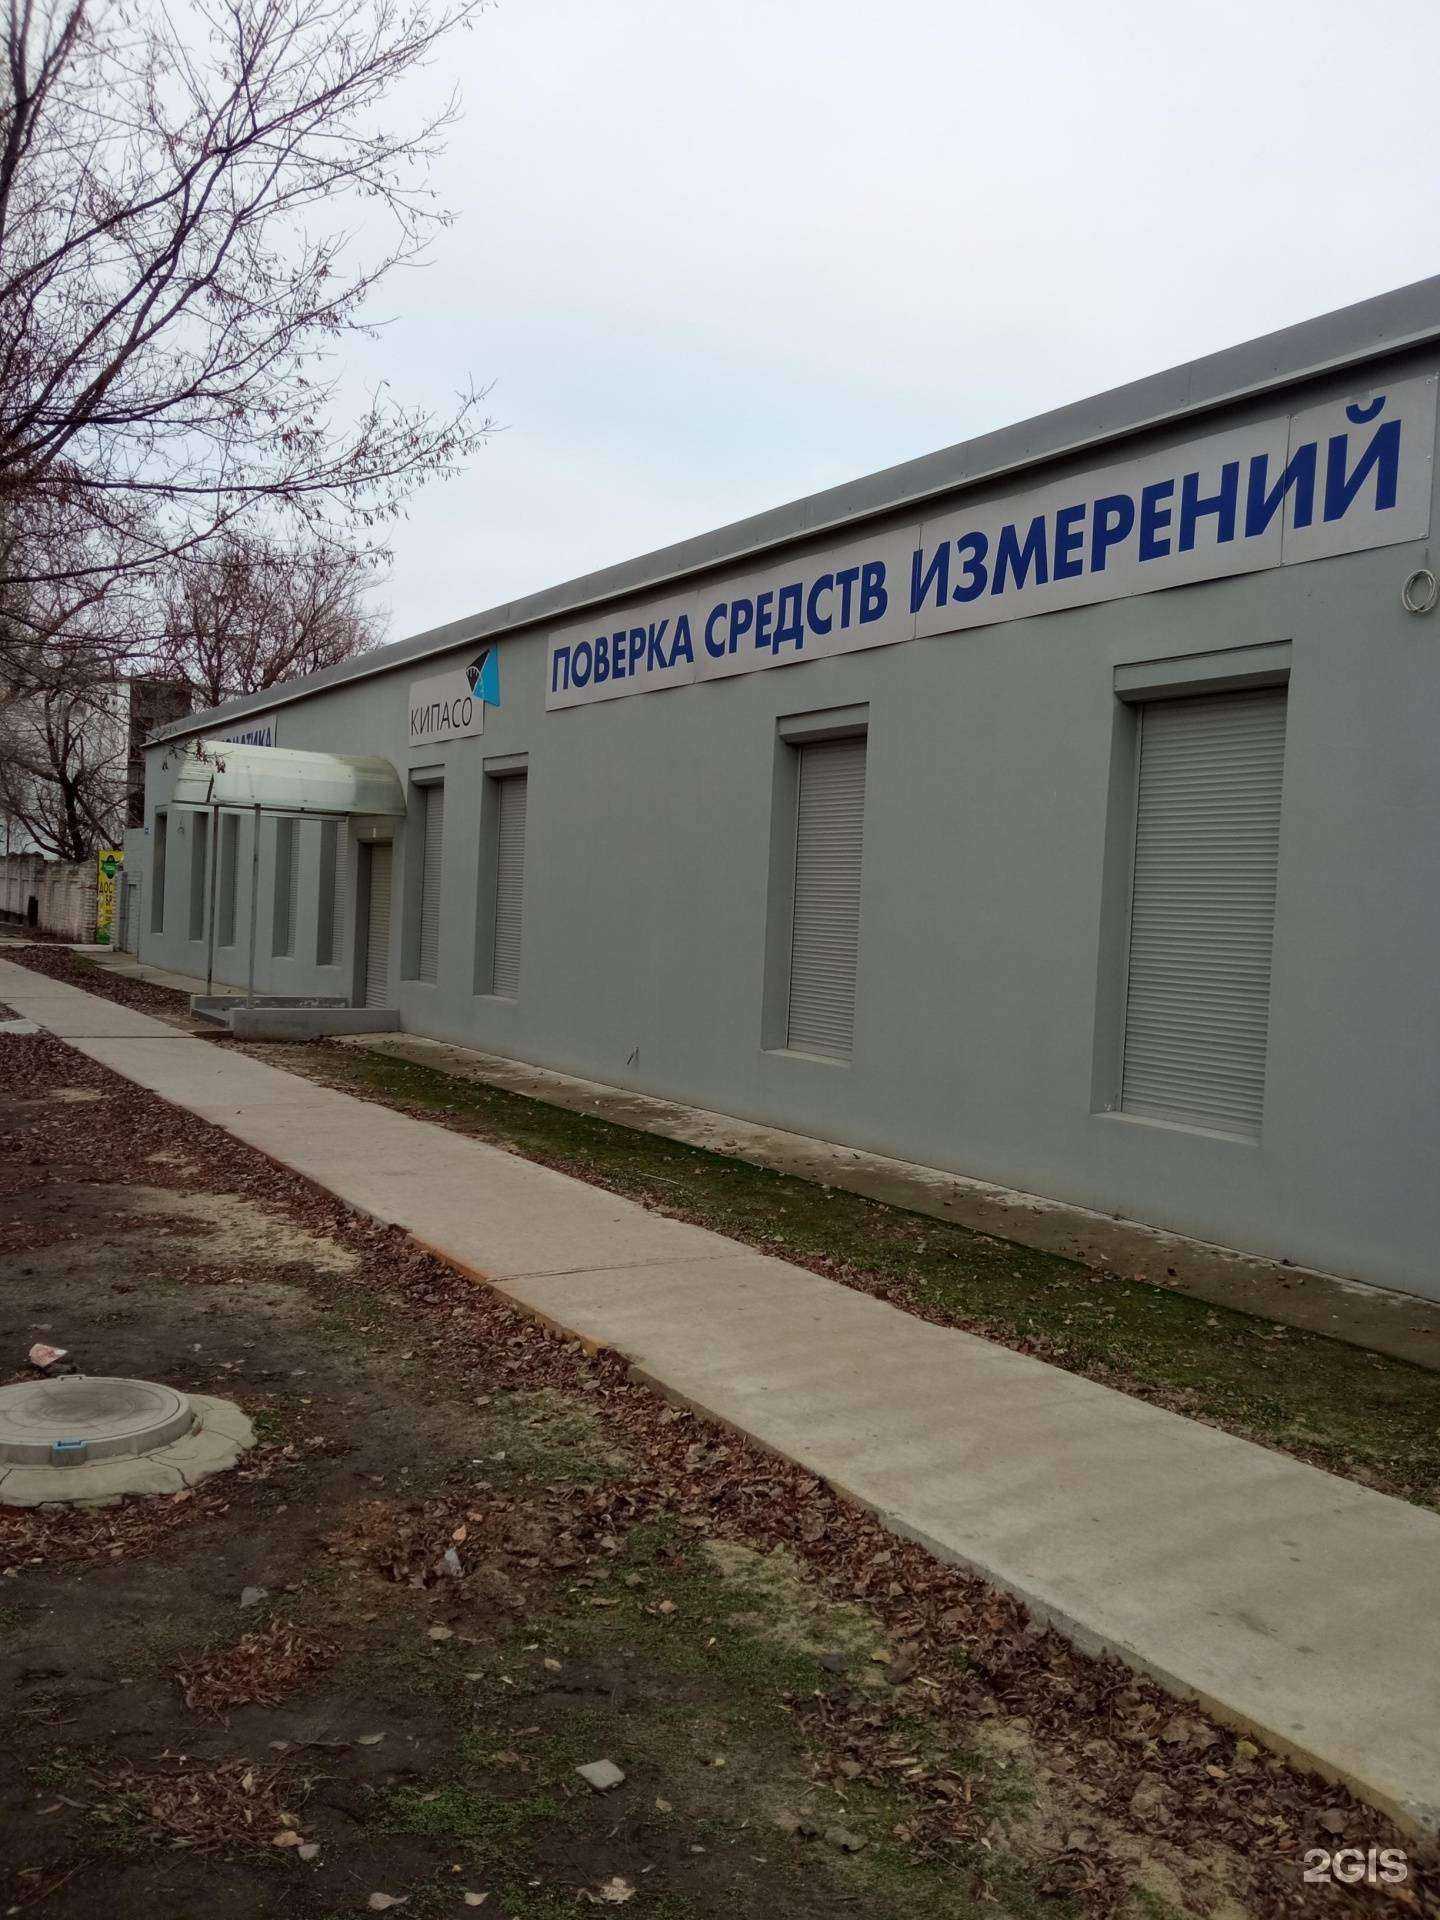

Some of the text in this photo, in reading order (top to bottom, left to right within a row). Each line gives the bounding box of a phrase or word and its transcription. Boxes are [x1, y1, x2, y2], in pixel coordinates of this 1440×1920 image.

[552, 395, 1402, 693] ПОВЕРКА СРЕДСТВ ИЗМЕРЕНИЙ
[410, 696, 473, 737] КИПАСО
